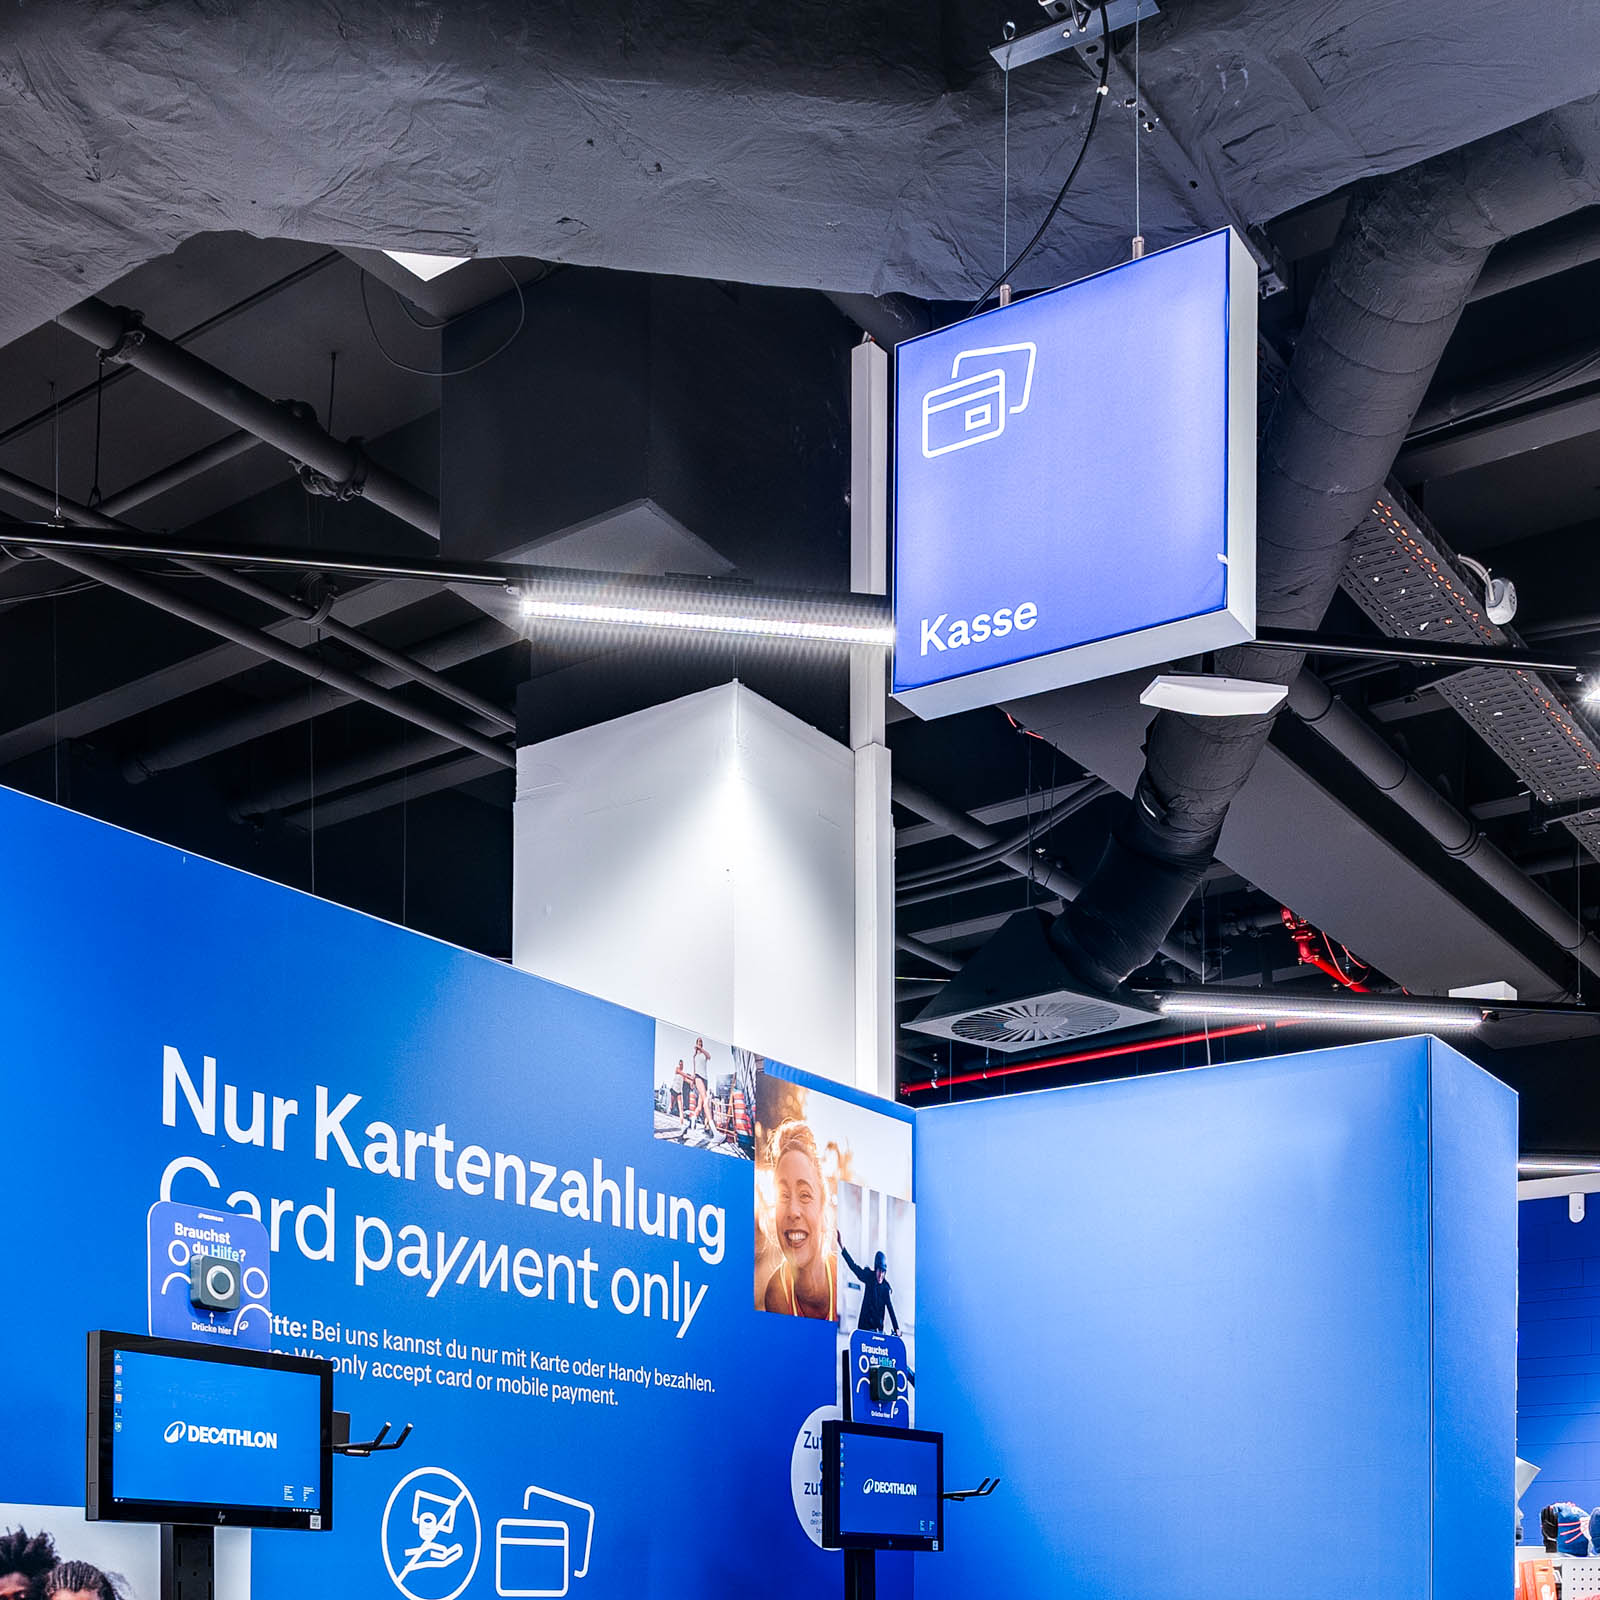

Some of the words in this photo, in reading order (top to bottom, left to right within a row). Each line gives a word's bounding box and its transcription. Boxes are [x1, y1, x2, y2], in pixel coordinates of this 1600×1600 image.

[921, 602, 1037, 656] Kasse
[163, 1046, 298, 1151] Nur
[316, 1086, 725, 1264] Kartenzahlung
[174, 1221, 231, 1245] Brauchst
[191, 1239, 210, 1257] du
[210, 1242, 247, 1263] Hilfe?
[356, 1216, 598, 1308] payment
[611, 1261, 708, 1338] only
[191, 1321, 218, 1334] Drücke
[217, 1325, 233, 1335] hier
[311, 1319, 341, 1343] Bei
[345, 1328, 379, 1349] uns
[384, 1329, 442, 1356] kannst
[445, 1338, 467, 1361] du
[471, 1346, 499, 1364] nur
[501, 1347, 527, 1369] mit
[530, 1350, 570, 1374] Karte
[571, 1358, 607, 1379] oder
[609, 1362, 651, 1388] Handy
[654, 1367, 716, 1393] bezahlen.
[334, 1354, 368, 1380] only
[371, 1361, 433, 1387] accept
[435, 1368, 473, 1389] card
[475, 1374, 494, 1391] or
[496, 1375, 549, 1398] mobile
[551, 1383, 619, 1406] payment.
[187, 1424, 278, 1449] DECATHLON
[874, 1480, 917, 1497] DECATHLON
